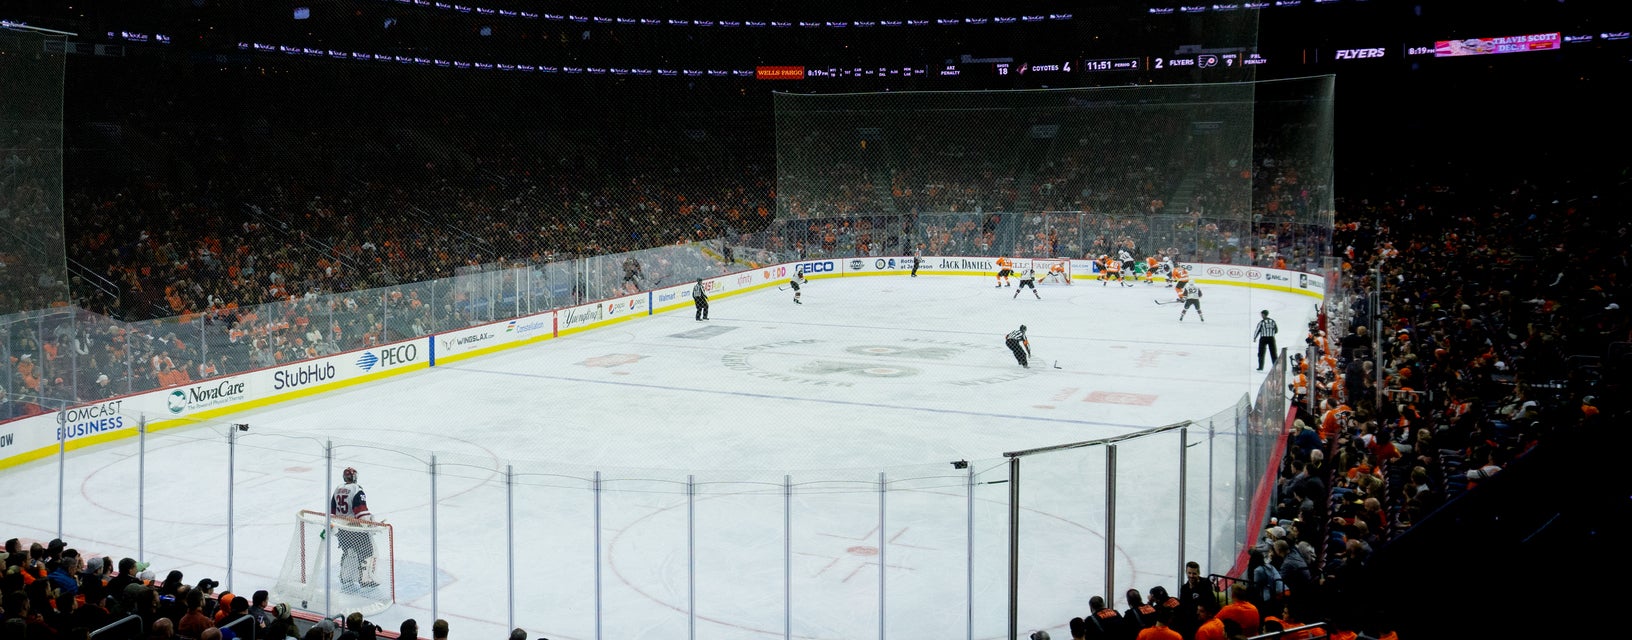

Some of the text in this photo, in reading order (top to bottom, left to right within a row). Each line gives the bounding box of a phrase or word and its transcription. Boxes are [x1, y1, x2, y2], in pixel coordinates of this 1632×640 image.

[1493, 33, 1558, 44] TRAVIS SCOTT
[1335, 48, 1386, 60] FLYERS
[1499, 44, 1519, 52] DEC.
[1062, 62, 1071, 72] 4
[1087, 61, 1111, 70] 11:51
[1131, 60, 1137, 68] 2
[1154, 58, 1163, 69] 2
[1226, 59, 1233, 67] 9
[795, 261, 834, 274] GEICO
[939, 258, 960, 269] JACK
[381, 344, 417, 367] PECO
[274, 362, 335, 390] StubHub
[188, 380, 244, 404] NovaCare
[56, 401, 123, 425] COMCAST
[57, 416, 123, 440] BUSINESS
[336, 494, 349, 514] 35
